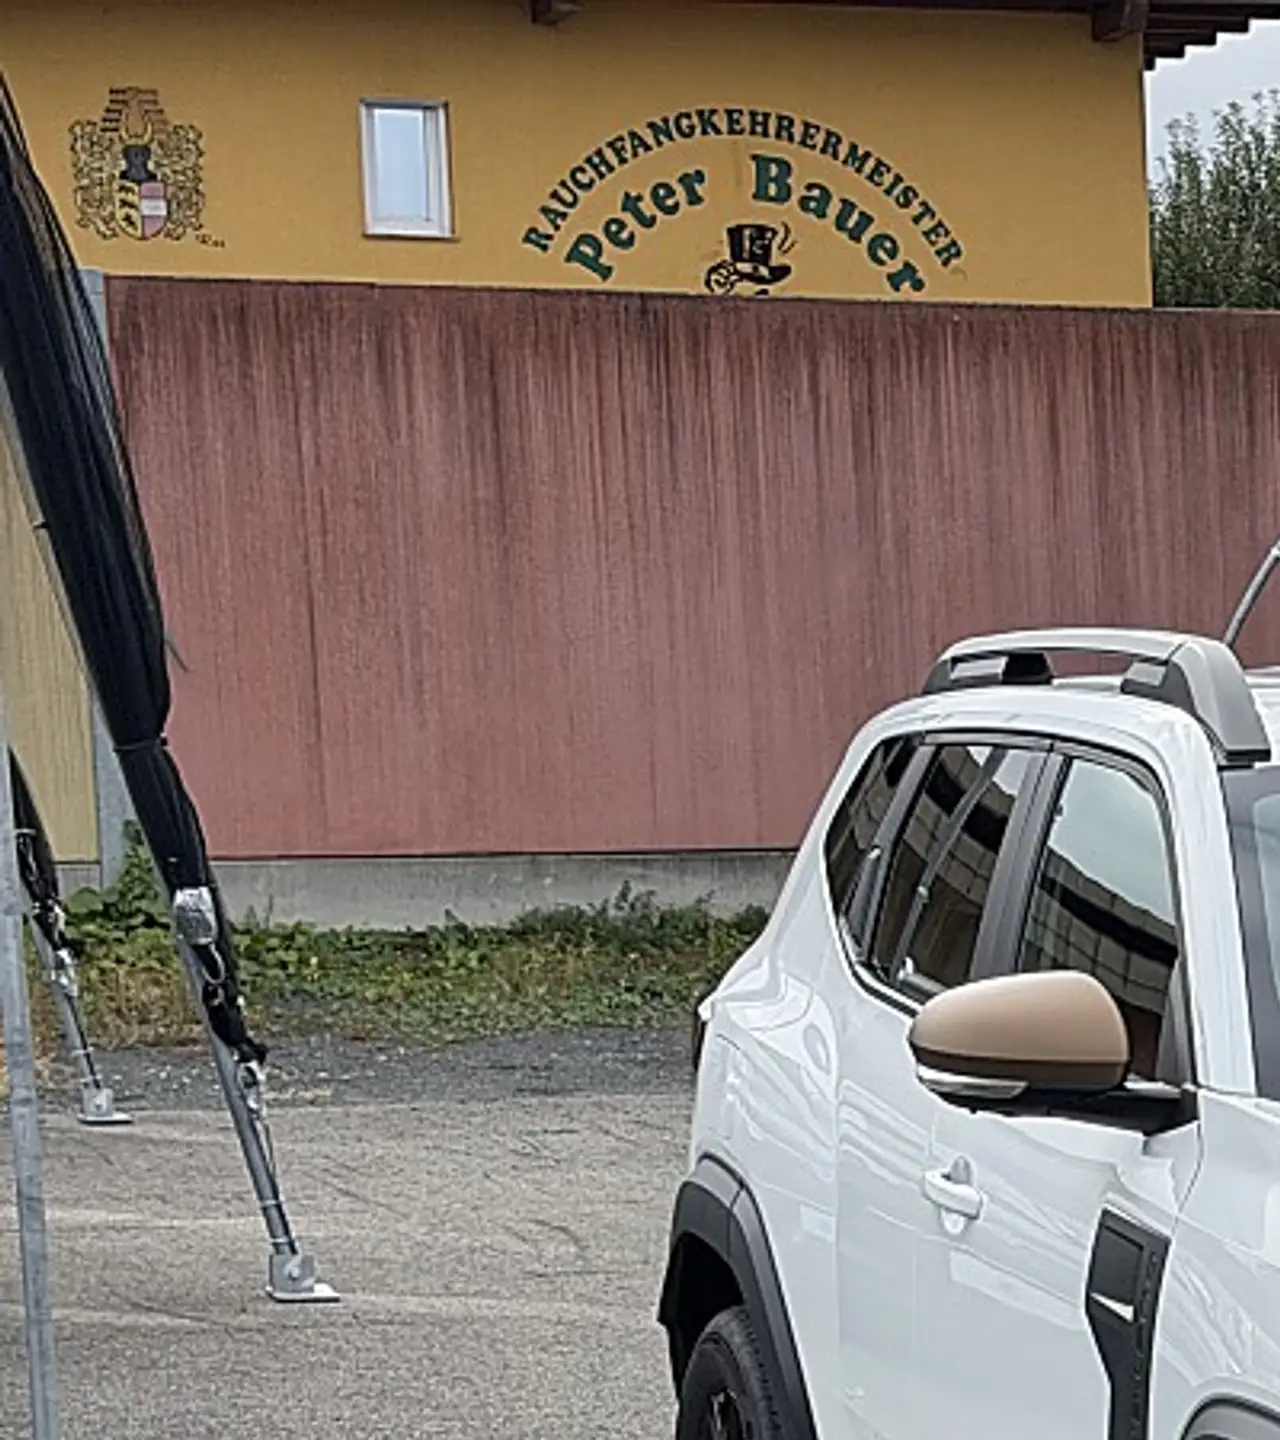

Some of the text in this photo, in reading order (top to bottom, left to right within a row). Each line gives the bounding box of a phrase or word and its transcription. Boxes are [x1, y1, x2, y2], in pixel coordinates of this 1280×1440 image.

[521, 107, 964, 268] RAUCHFANGKEHRERMEISTER
[564, 153, 926, 293] Peter Bauer
